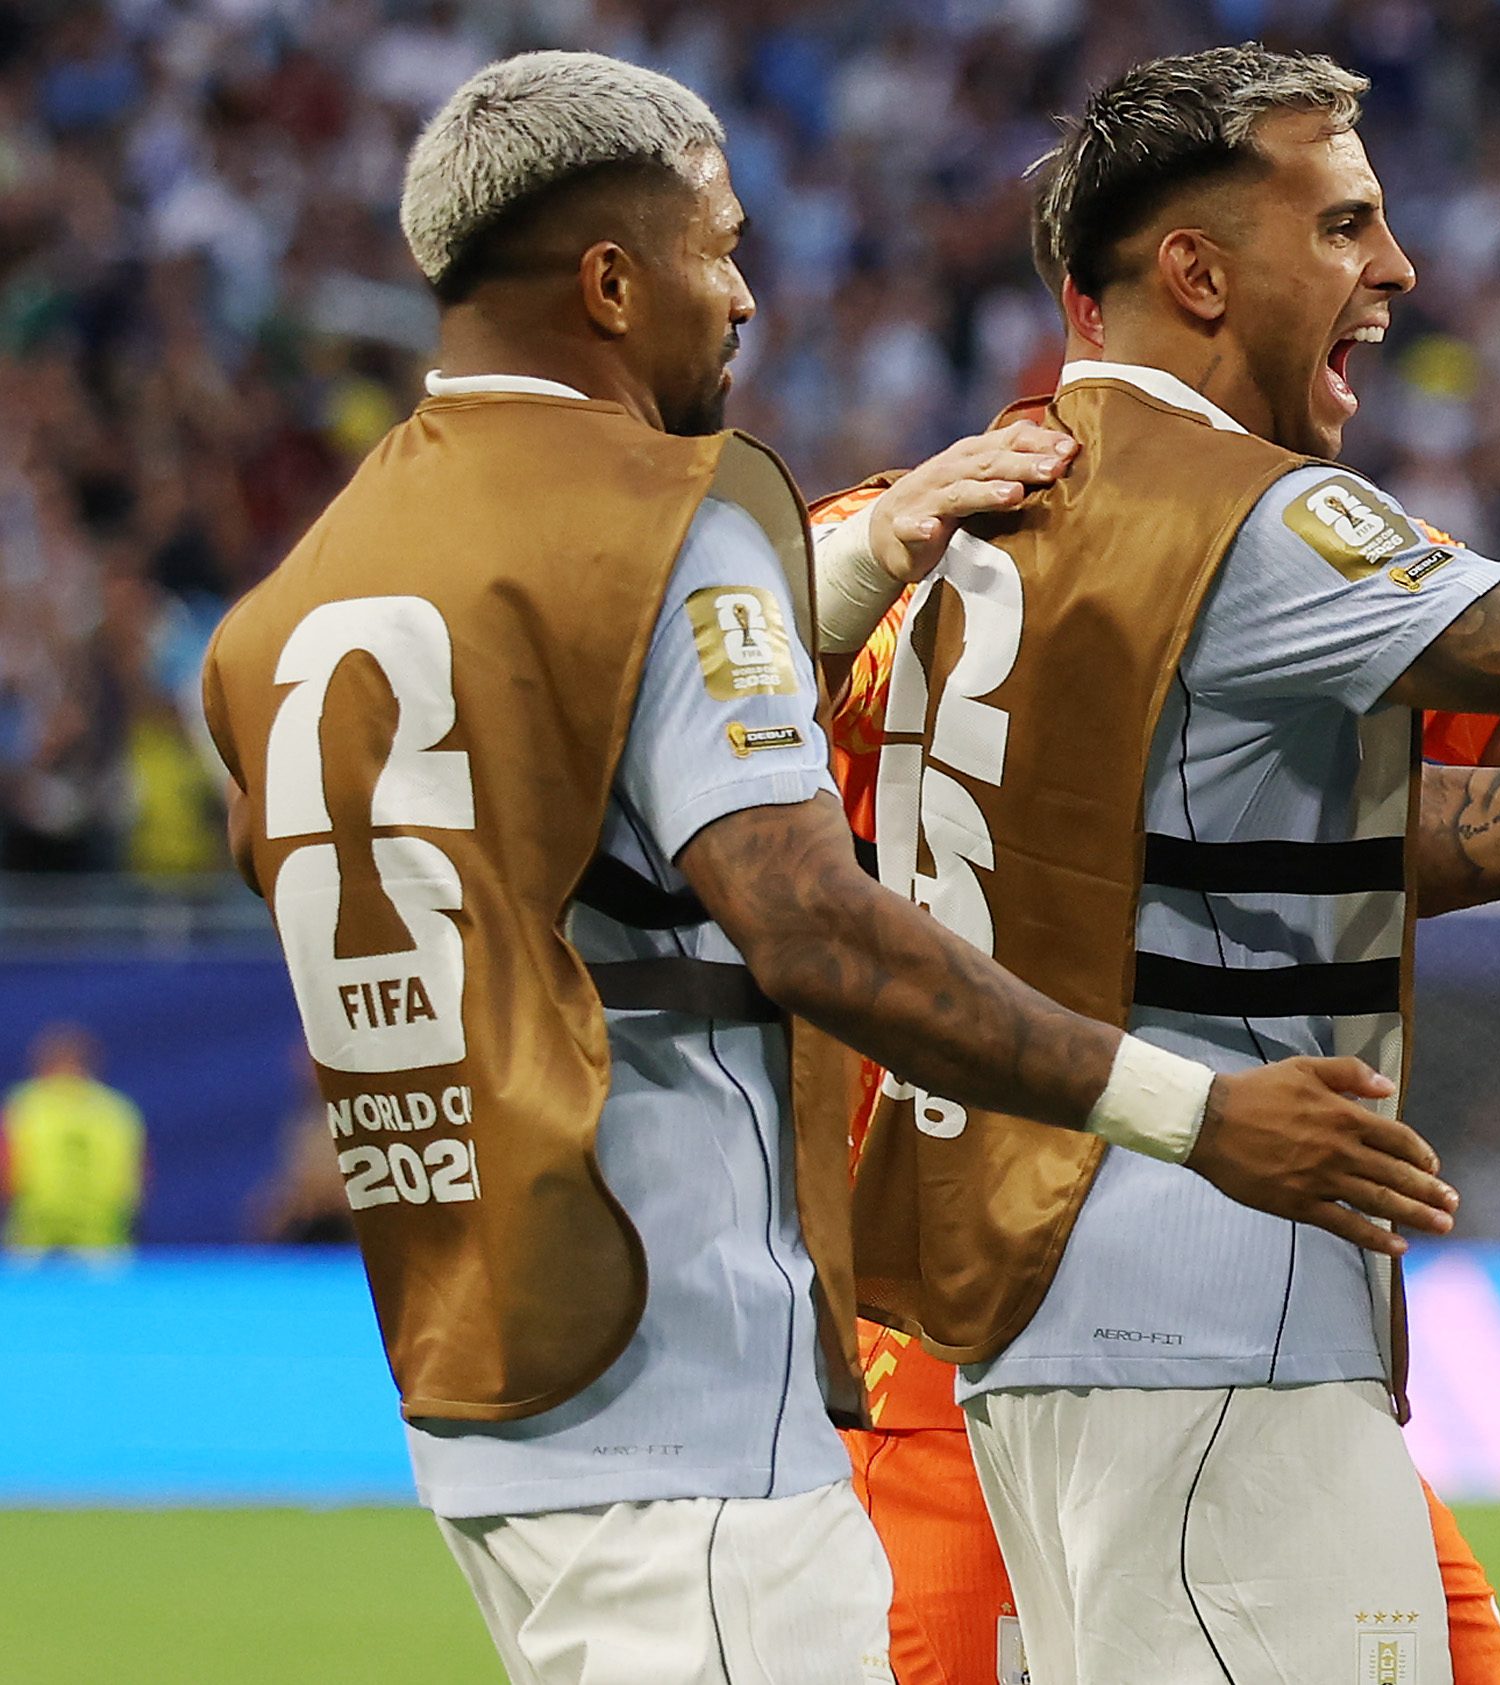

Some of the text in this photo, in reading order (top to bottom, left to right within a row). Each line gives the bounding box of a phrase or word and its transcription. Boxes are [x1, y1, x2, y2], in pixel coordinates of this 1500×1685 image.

[1364, 534, 1404, 564] 2026
[1407, 551, 1443, 577] DEBUT
[732, 674, 781, 689] 2026
[746, 730, 794, 742] DEBUT
[338, 976, 437, 1031] FIFA
[338, 1139, 481, 1210] 202
[1093, 1328, 1183, 1345] AERO-FIT
